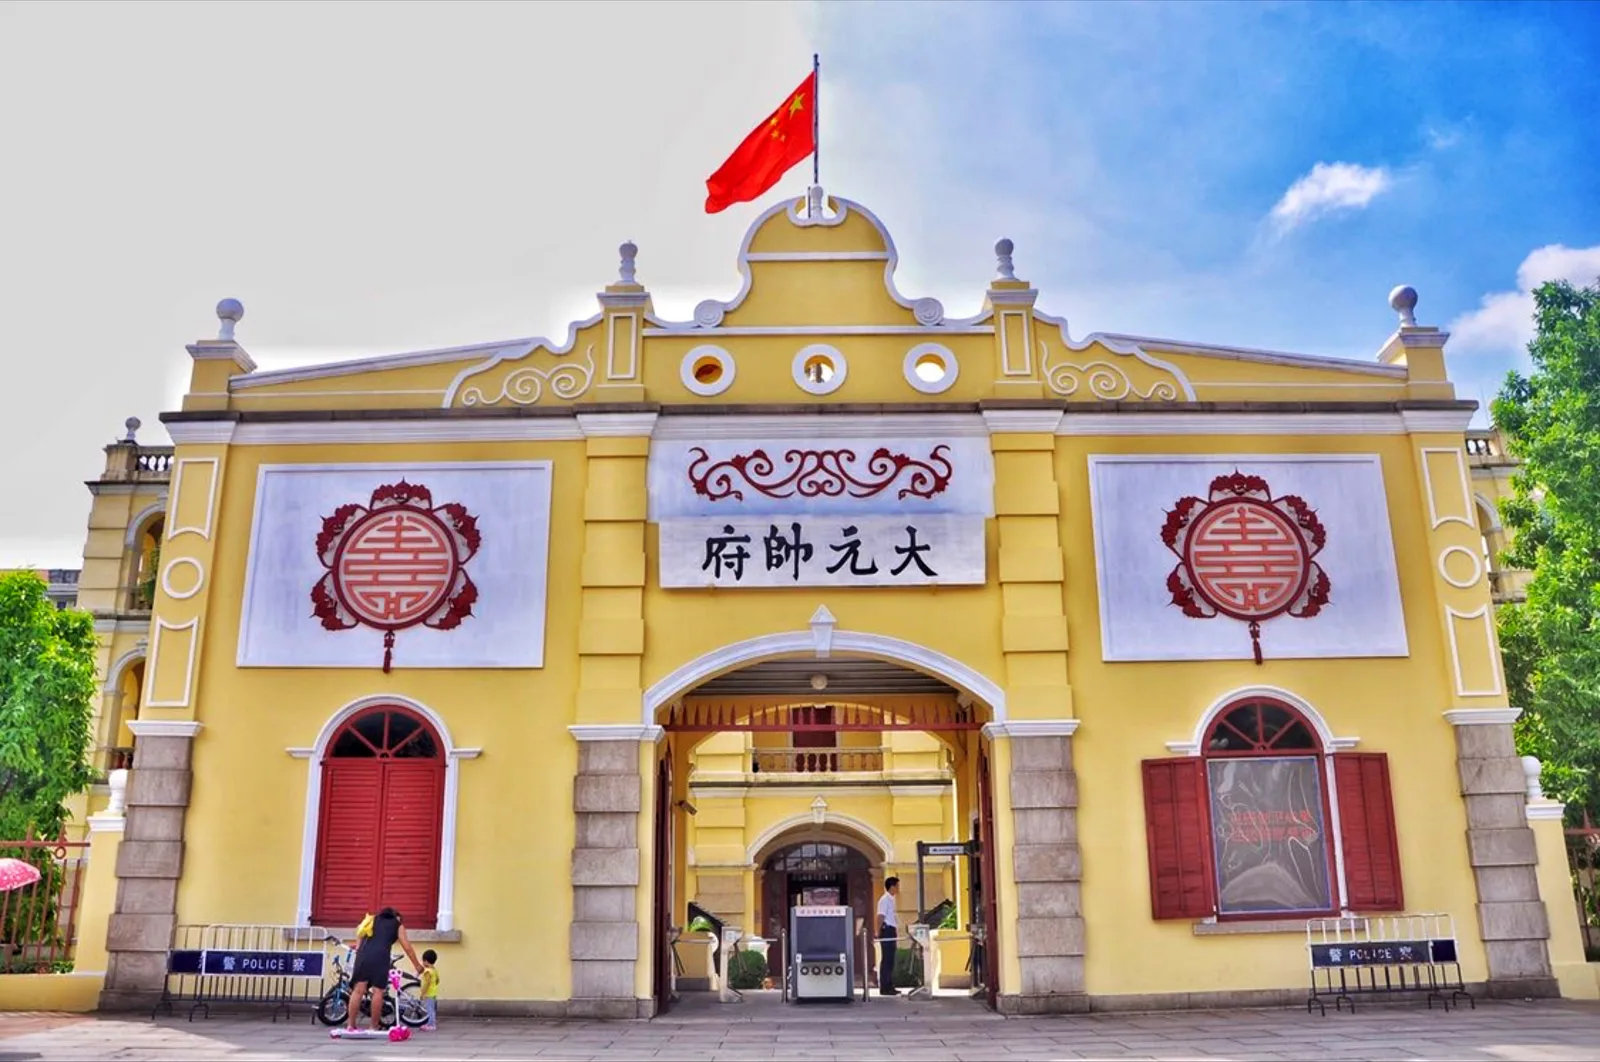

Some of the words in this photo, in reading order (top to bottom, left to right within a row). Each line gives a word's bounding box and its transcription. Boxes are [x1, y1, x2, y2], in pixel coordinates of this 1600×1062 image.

[1349, 948, 1392, 961] POLICE
[223, 956, 235, 971] 警
[242, 958, 285, 971] POLICE
[292, 957, 305, 972] 察
